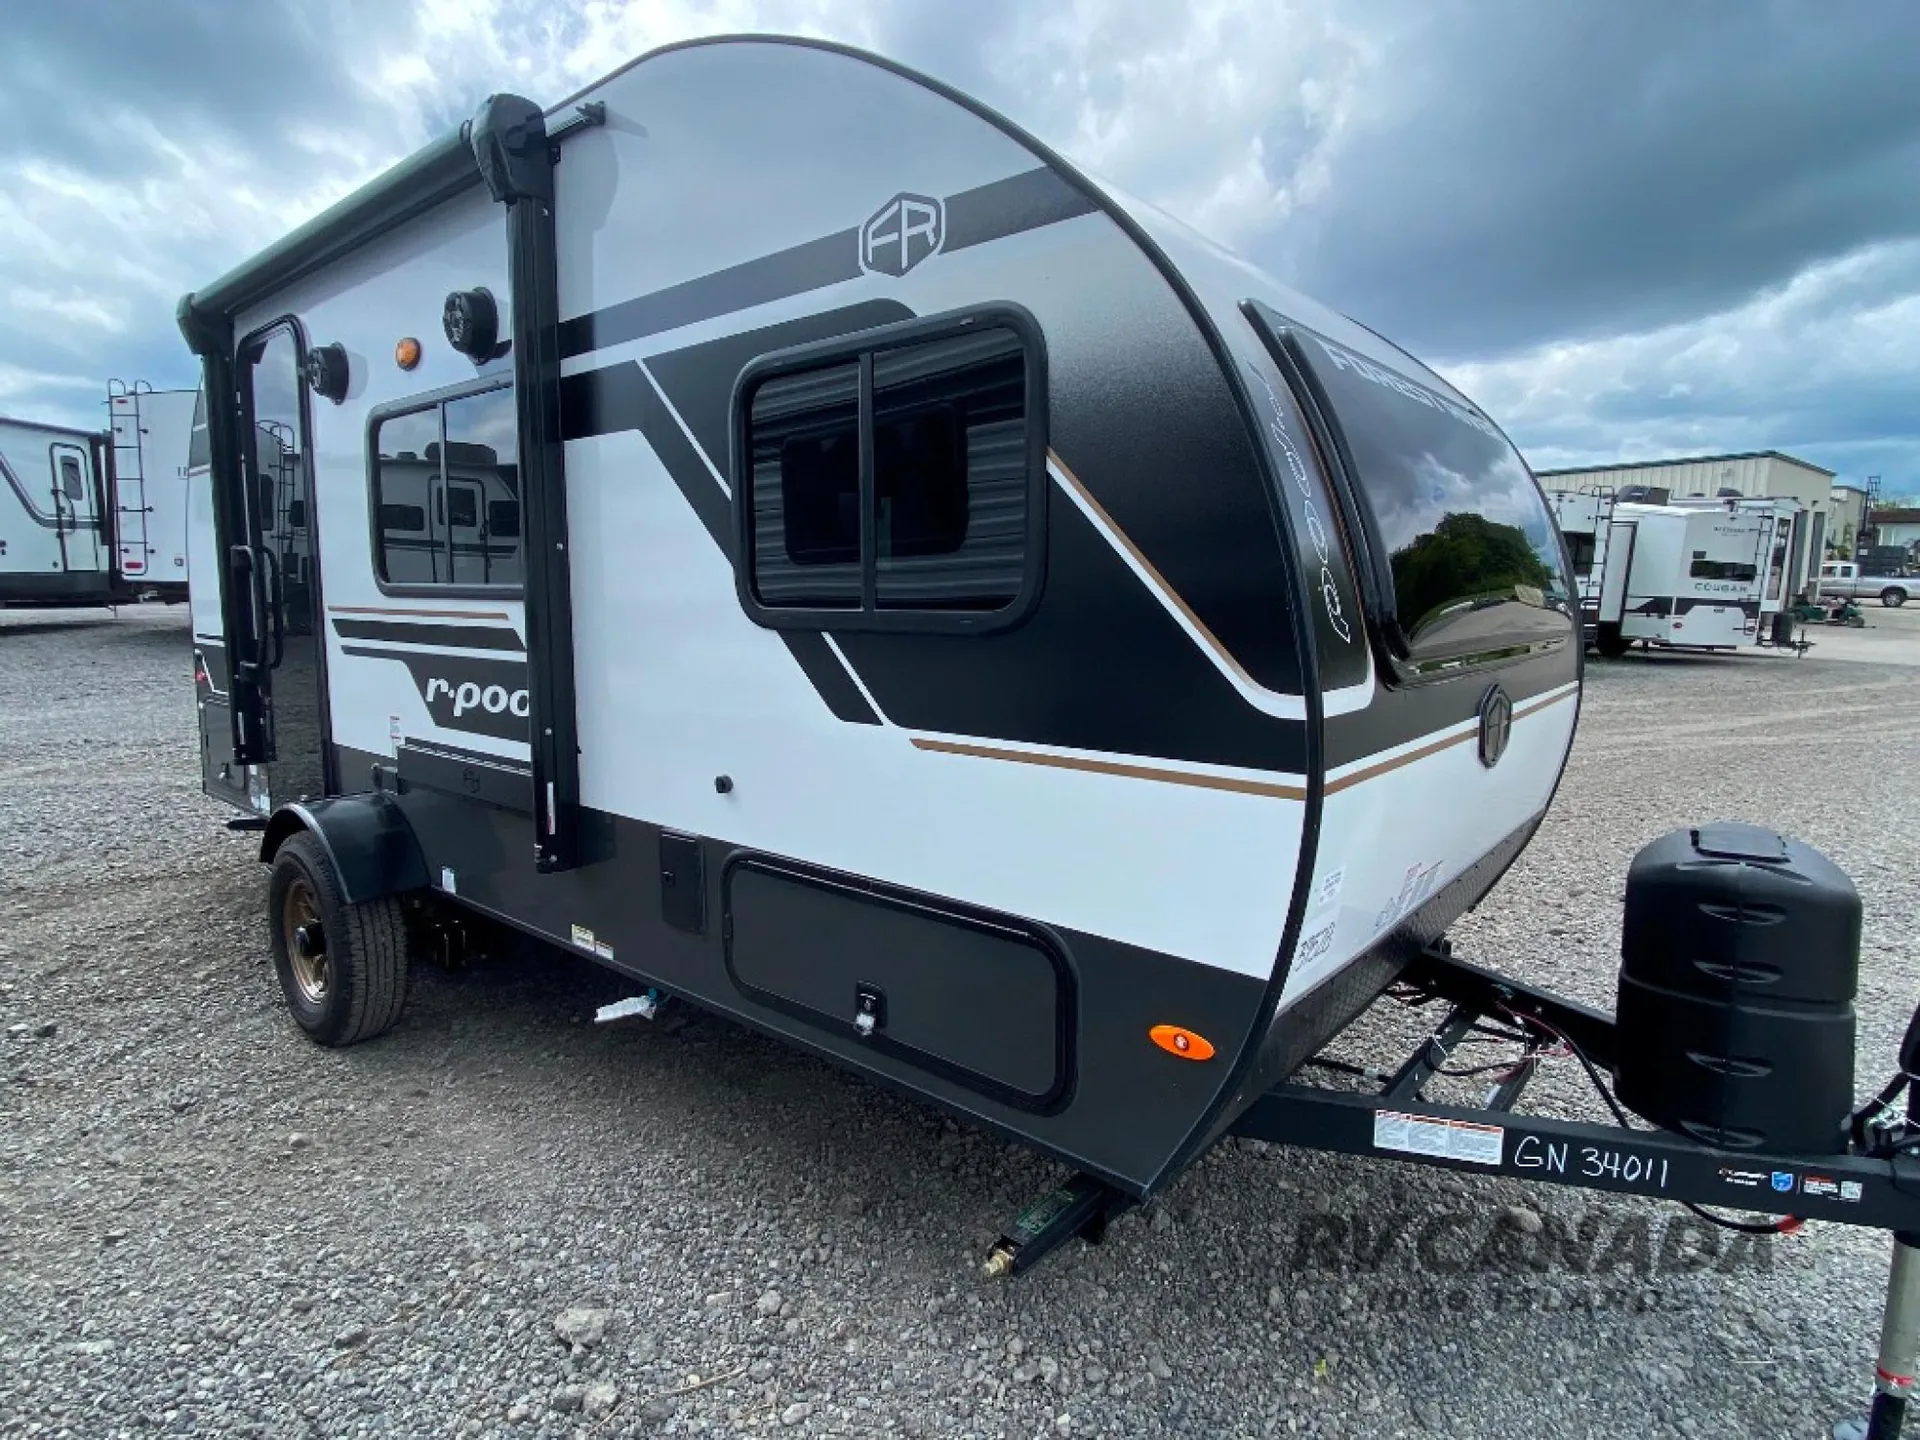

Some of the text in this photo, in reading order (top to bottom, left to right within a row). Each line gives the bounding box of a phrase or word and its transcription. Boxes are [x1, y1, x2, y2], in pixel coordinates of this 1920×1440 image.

[1694, 581, 1748, 594] COUGAR
[1514, 1135, 1569, 1174] GN
[1581, 1147, 1668, 1188] 34011
